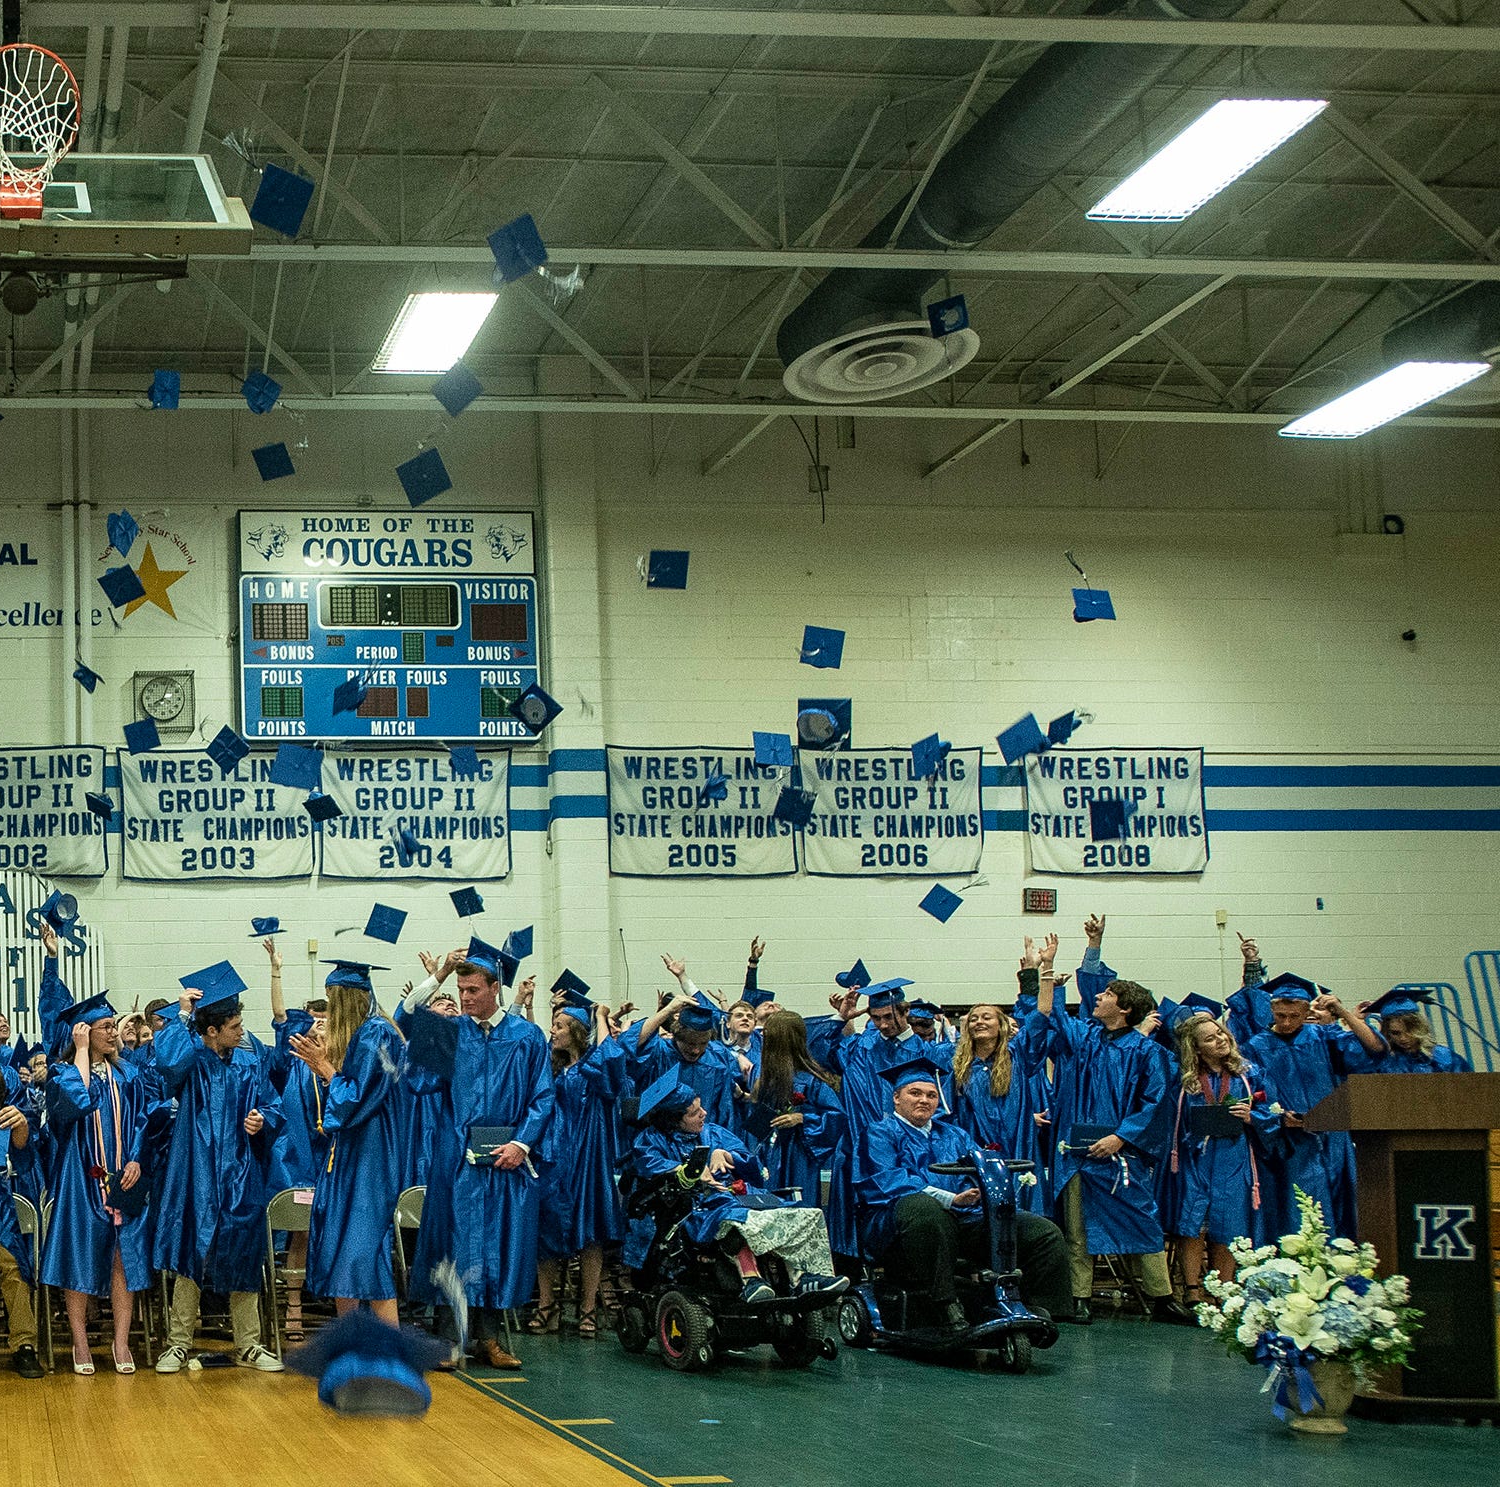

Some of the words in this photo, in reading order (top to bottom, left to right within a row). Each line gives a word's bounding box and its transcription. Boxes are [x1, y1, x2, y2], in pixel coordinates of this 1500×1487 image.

[302, 518, 370, 532] HOME
[383, 518, 412, 532] OF
[428, 518, 474, 532] THE
[148, 525, 170, 538] Star
[171, 534, 196, 565] School
[302, 538, 473, 568] COUGARS
[250, 582, 309, 598] HOME
[464, 583, 530, 600] VISITOR
[270, 646, 314, 660] BONUS
[356, 647, 398, 660] PERIOD
[468, 647, 510, 660] BONUS
[261, 670, 302, 685] FOULS
[406, 670, 447, 685] FOULS
[480, 670, 521, 685] FOULS
[258, 722, 306, 736] POINTS
[371, 722, 416, 736] MATCH
[480, 722, 526, 736] POINTS
[139, 759, 275, 783] WRESLIN
[815, 758, 966, 781] WRESTLNG
[1038, 756, 1190, 780] WRESTLING
[52, 784, 74, 808] II
[158, 788, 246, 813] GROUP
[254, 788, 276, 812] II
[356, 787, 444, 810] GROUP
[454, 788, 475, 810] II
[738, 786, 760, 809] II
[834, 786, 918, 810] GROUP
[928, 786, 950, 810] II
[1156, 786, 1165, 808] I
[128, 816, 184, 842] STATE
[203, 815, 309, 841] CHAMPIONS
[327, 816, 384, 840] STATE
[396, 815, 505, 840] CHAMPIONS
[614, 812, 672, 838] STATE
[682, 814, 790, 838] CHAMPIONS
[808, 813, 862, 838] STATE
[874, 814, 978, 838] CHAMPIONS
[1031, 812, 1086, 838] STATE
[1124, 815, 1202, 838] MPIONS
[182, 846, 254, 872] 2003
[668, 844, 736, 868] 2005
[861, 844, 928, 867] 2006
[1084, 845, 1150, 868] 2008
[1415, 1204, 1476, 1260] K
